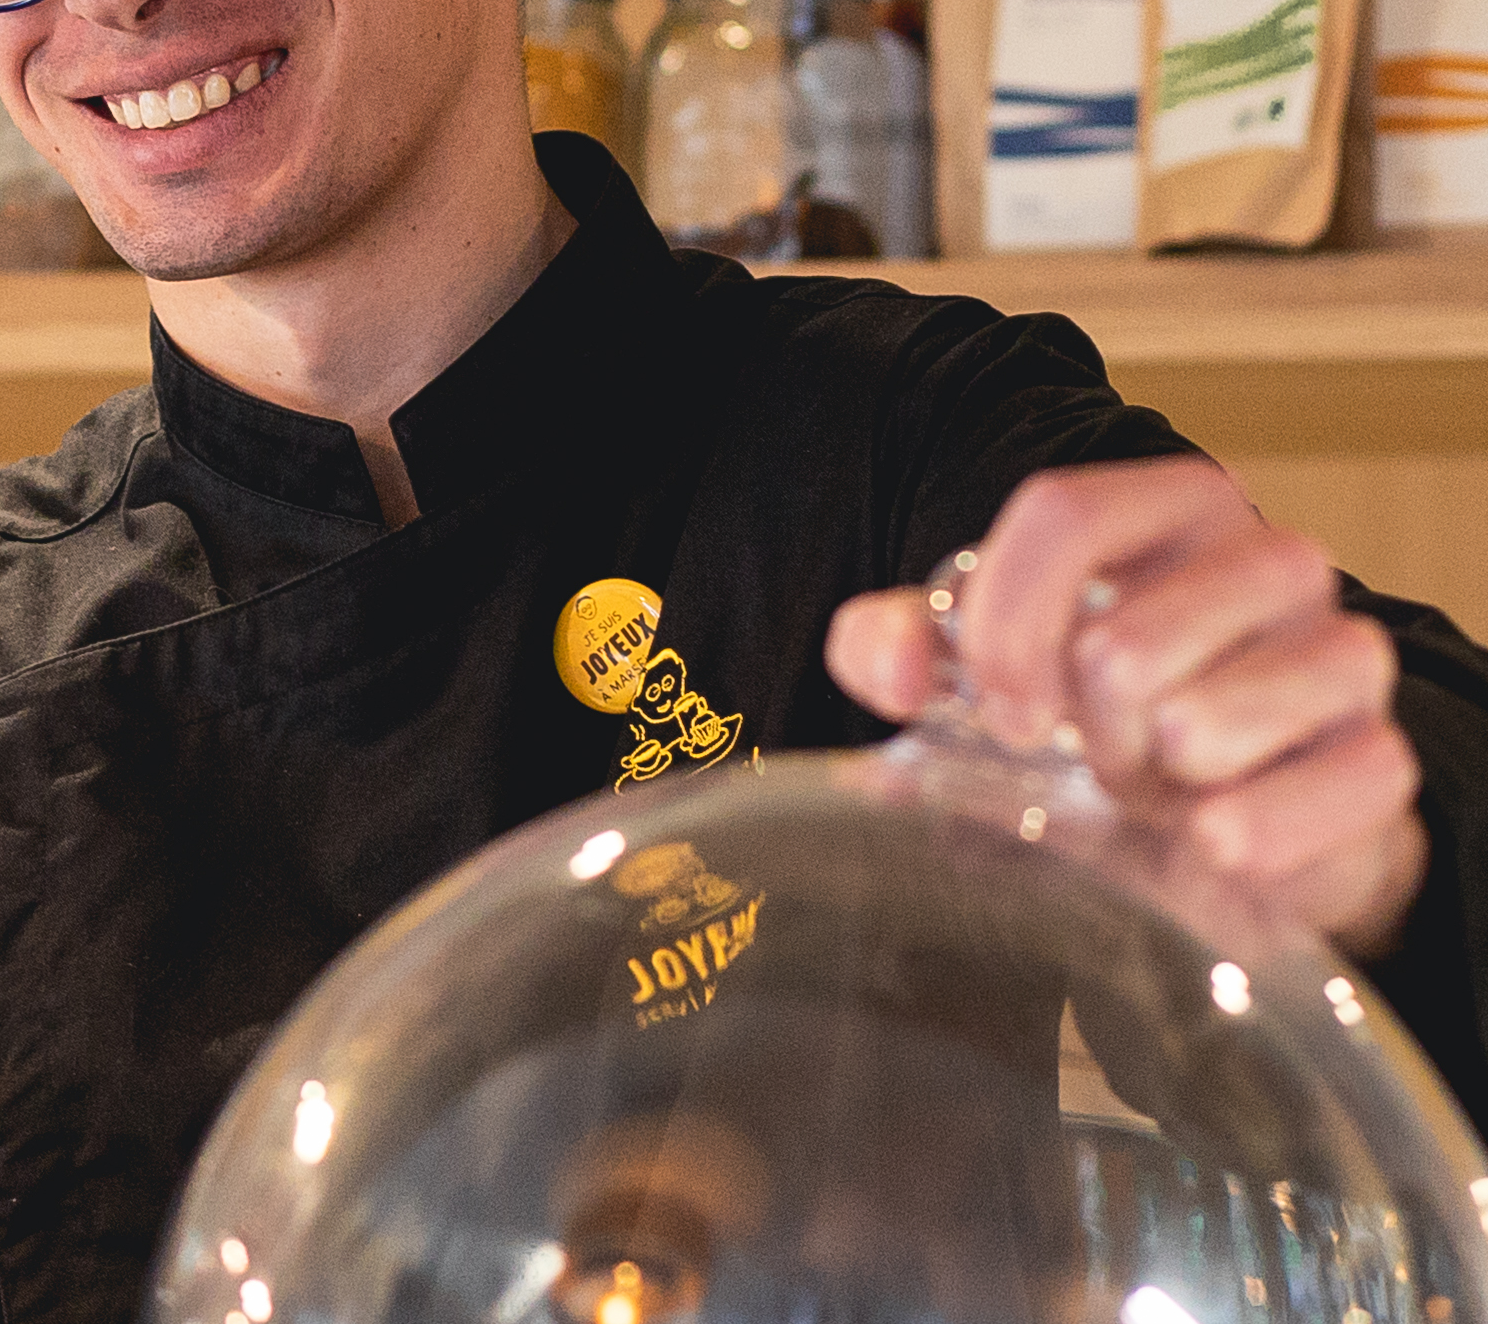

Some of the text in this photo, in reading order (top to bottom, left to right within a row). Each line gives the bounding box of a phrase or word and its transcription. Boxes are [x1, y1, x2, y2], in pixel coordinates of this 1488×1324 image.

[580, 612, 656, 686] JOYEUX
[584, 625, 600, 648] JE
[610, 656, 649, 694] MARSE
